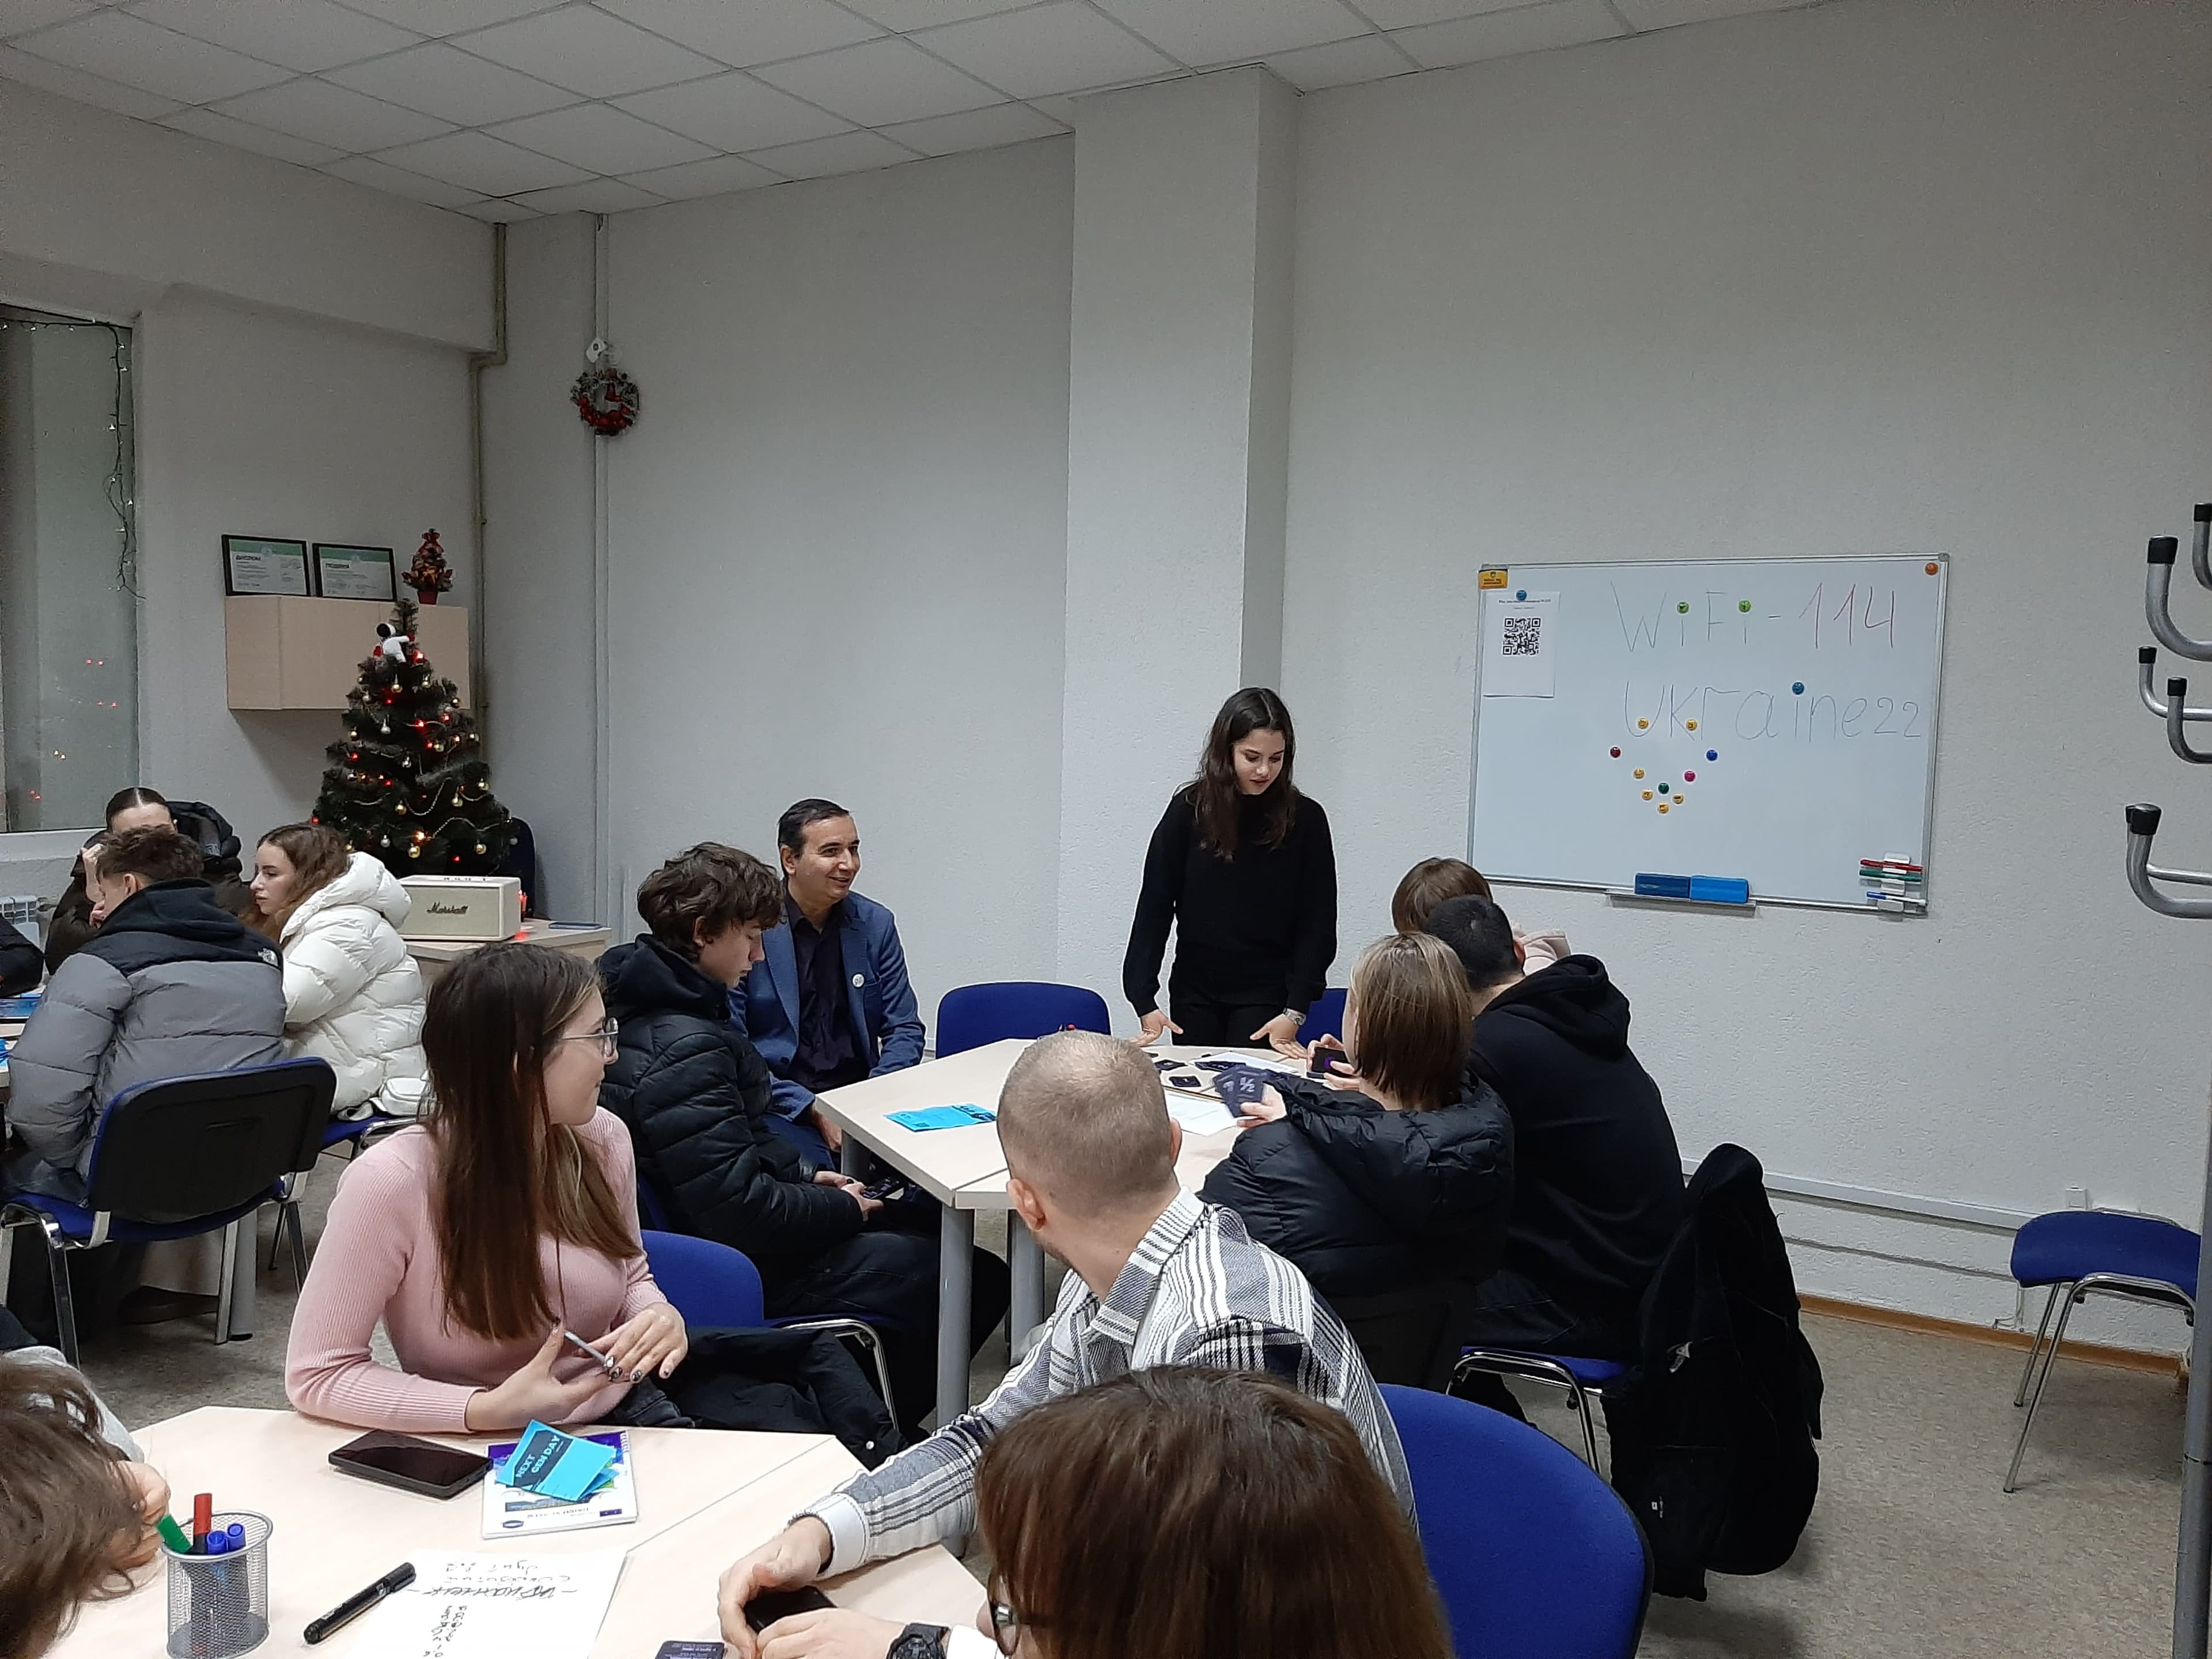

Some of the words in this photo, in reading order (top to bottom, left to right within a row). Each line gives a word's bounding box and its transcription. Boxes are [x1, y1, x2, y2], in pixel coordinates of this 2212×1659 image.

[426, 902, 469, 915] Marshall
[546, 1435, 560, 1457] DAY
[515, 1454, 535, 1478] NEXT
